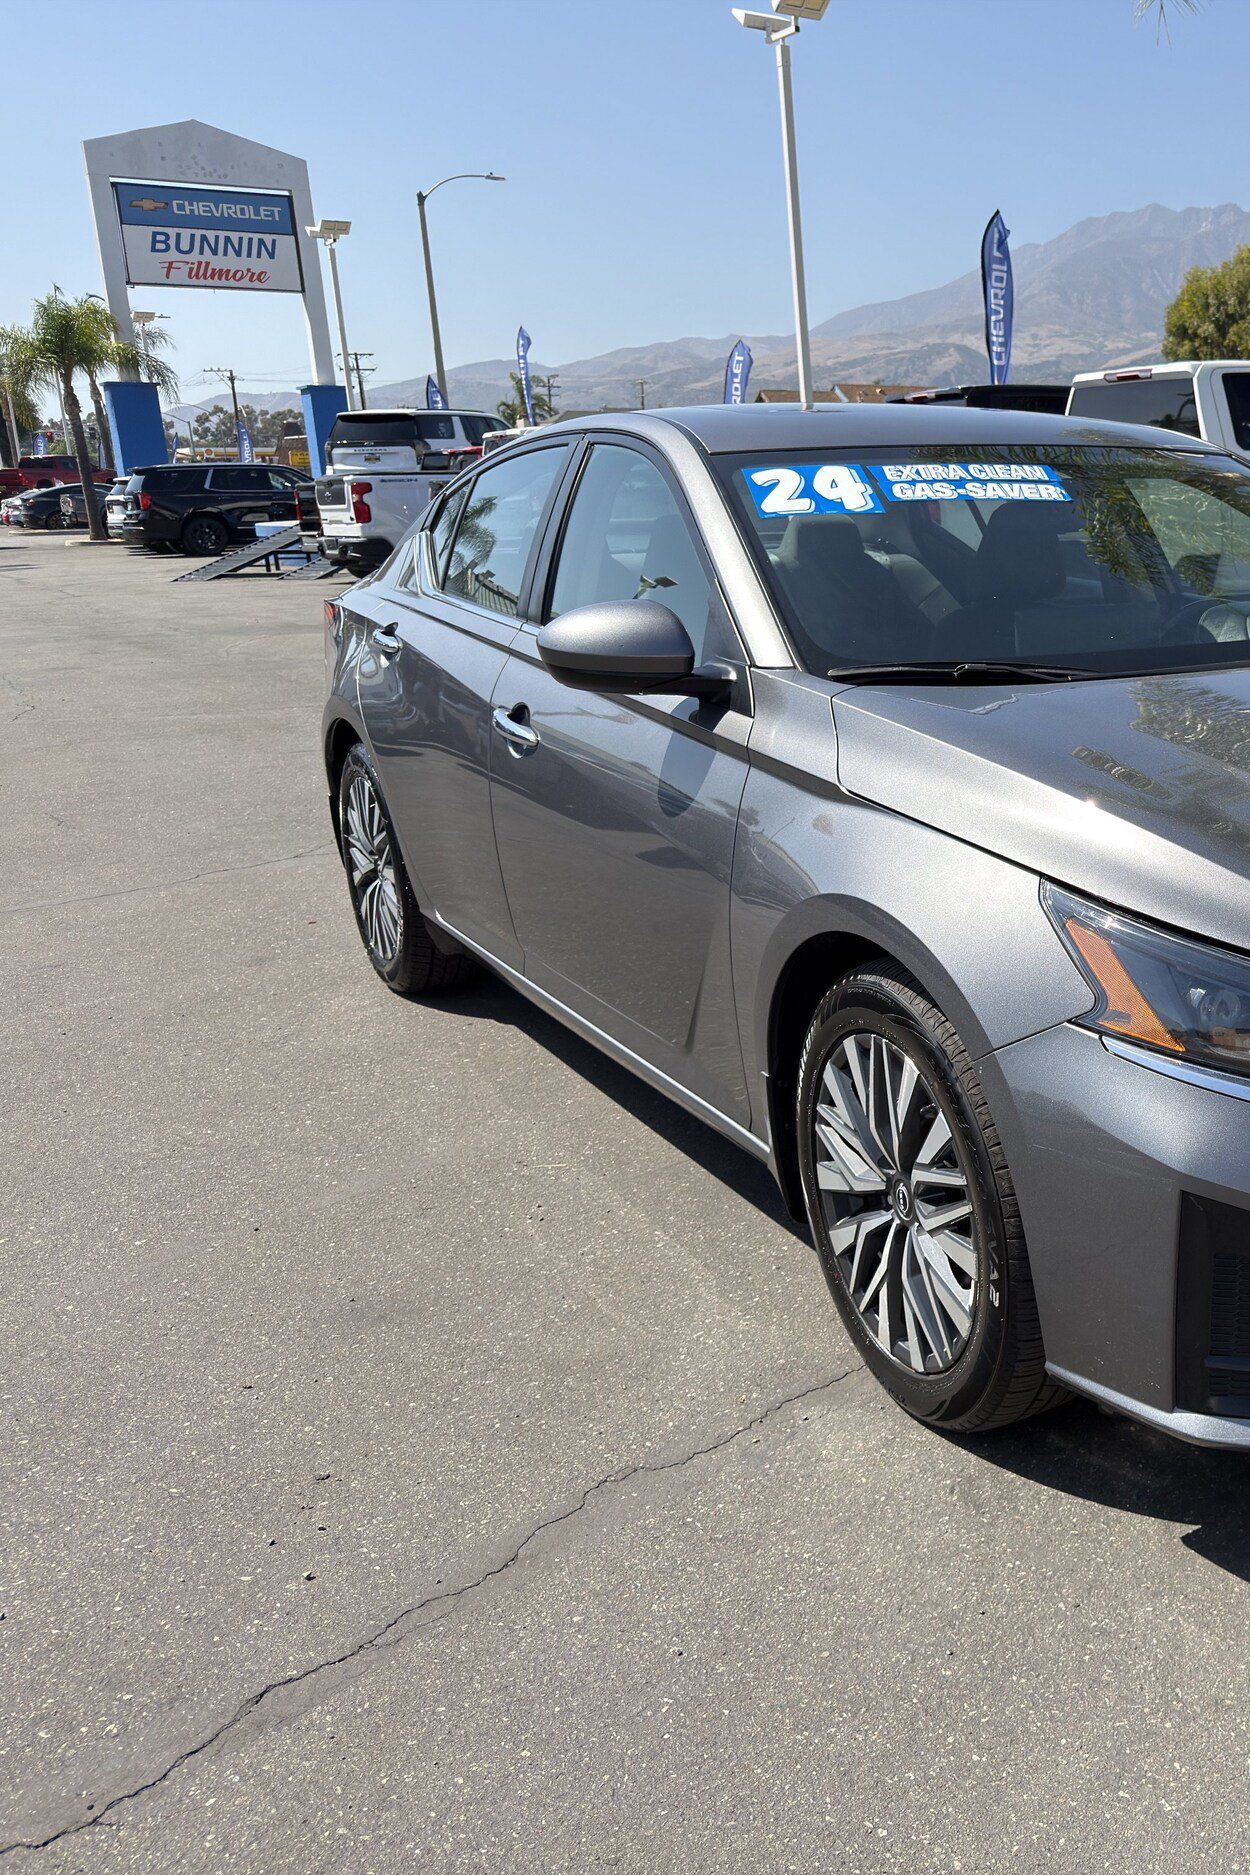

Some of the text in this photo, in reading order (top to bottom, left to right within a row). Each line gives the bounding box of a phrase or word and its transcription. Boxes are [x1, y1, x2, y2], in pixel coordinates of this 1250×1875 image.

[172, 200, 281, 221] CHEVROLET
[150, 231, 277, 260] BUNNIN
[158, 260, 270, 283] Fillmore
[751, 464, 1050, 514] 24 EXTRA CLEAN
